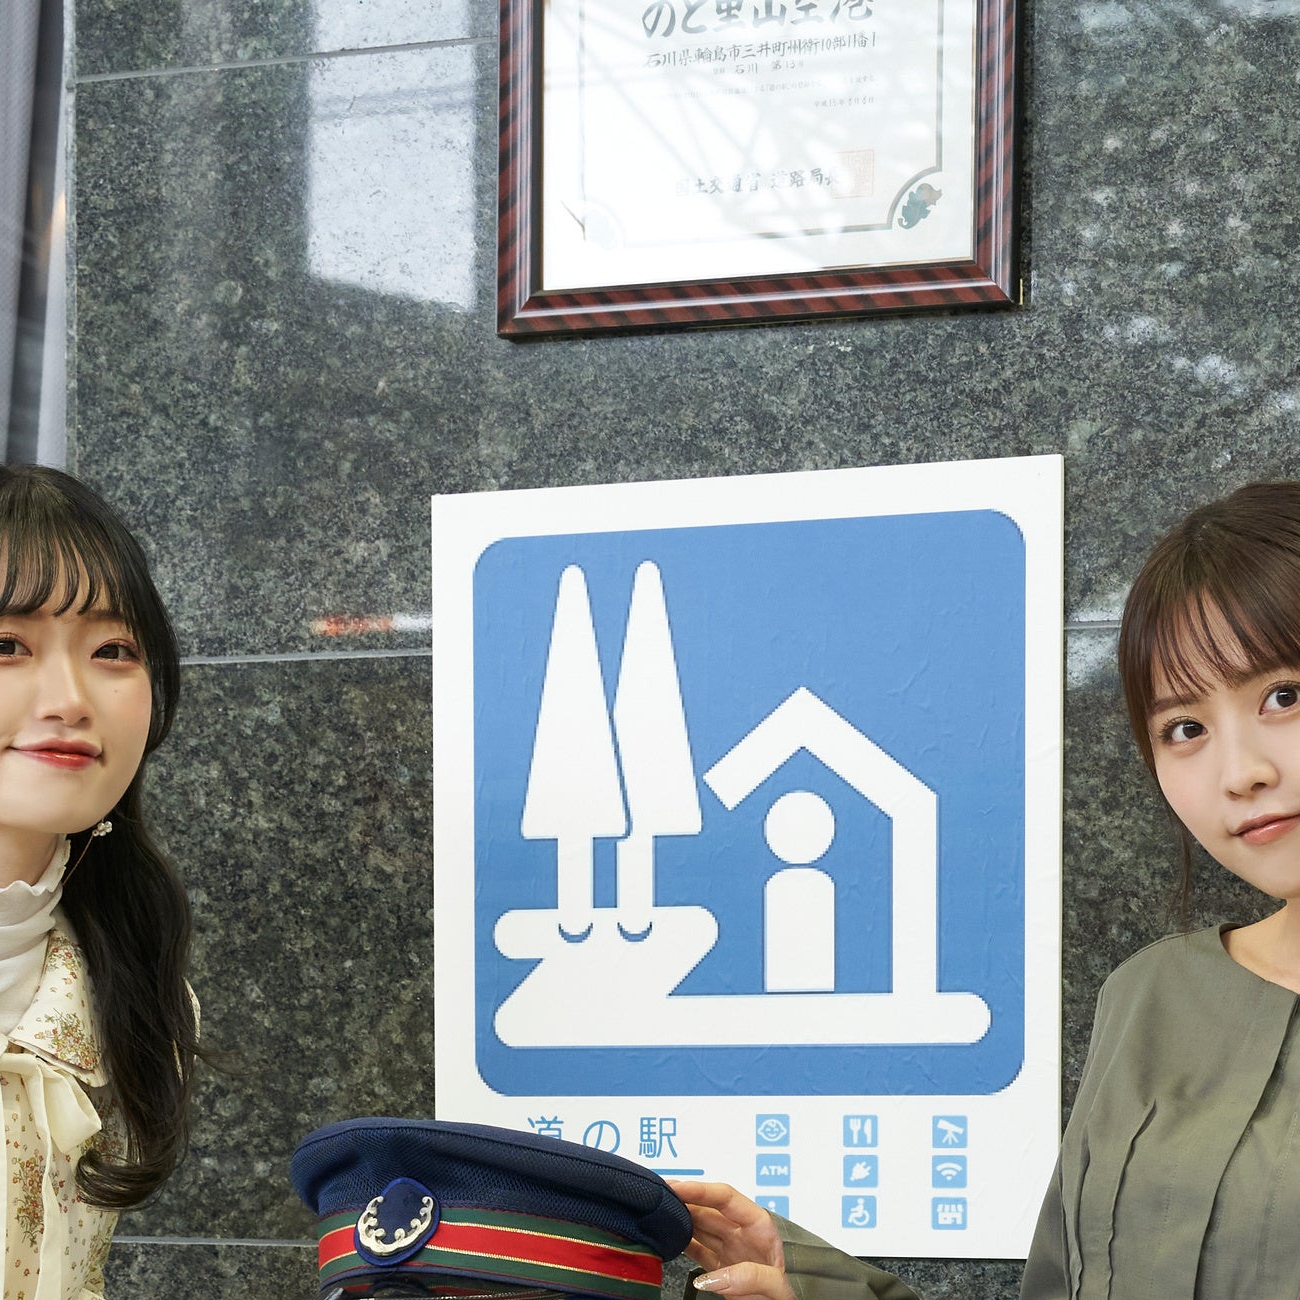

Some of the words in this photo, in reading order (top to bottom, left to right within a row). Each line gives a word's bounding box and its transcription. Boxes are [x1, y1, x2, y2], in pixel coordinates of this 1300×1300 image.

[527, 1115, 678, 1159] 道の駅
[760, 1165, 789, 1176] ATM
